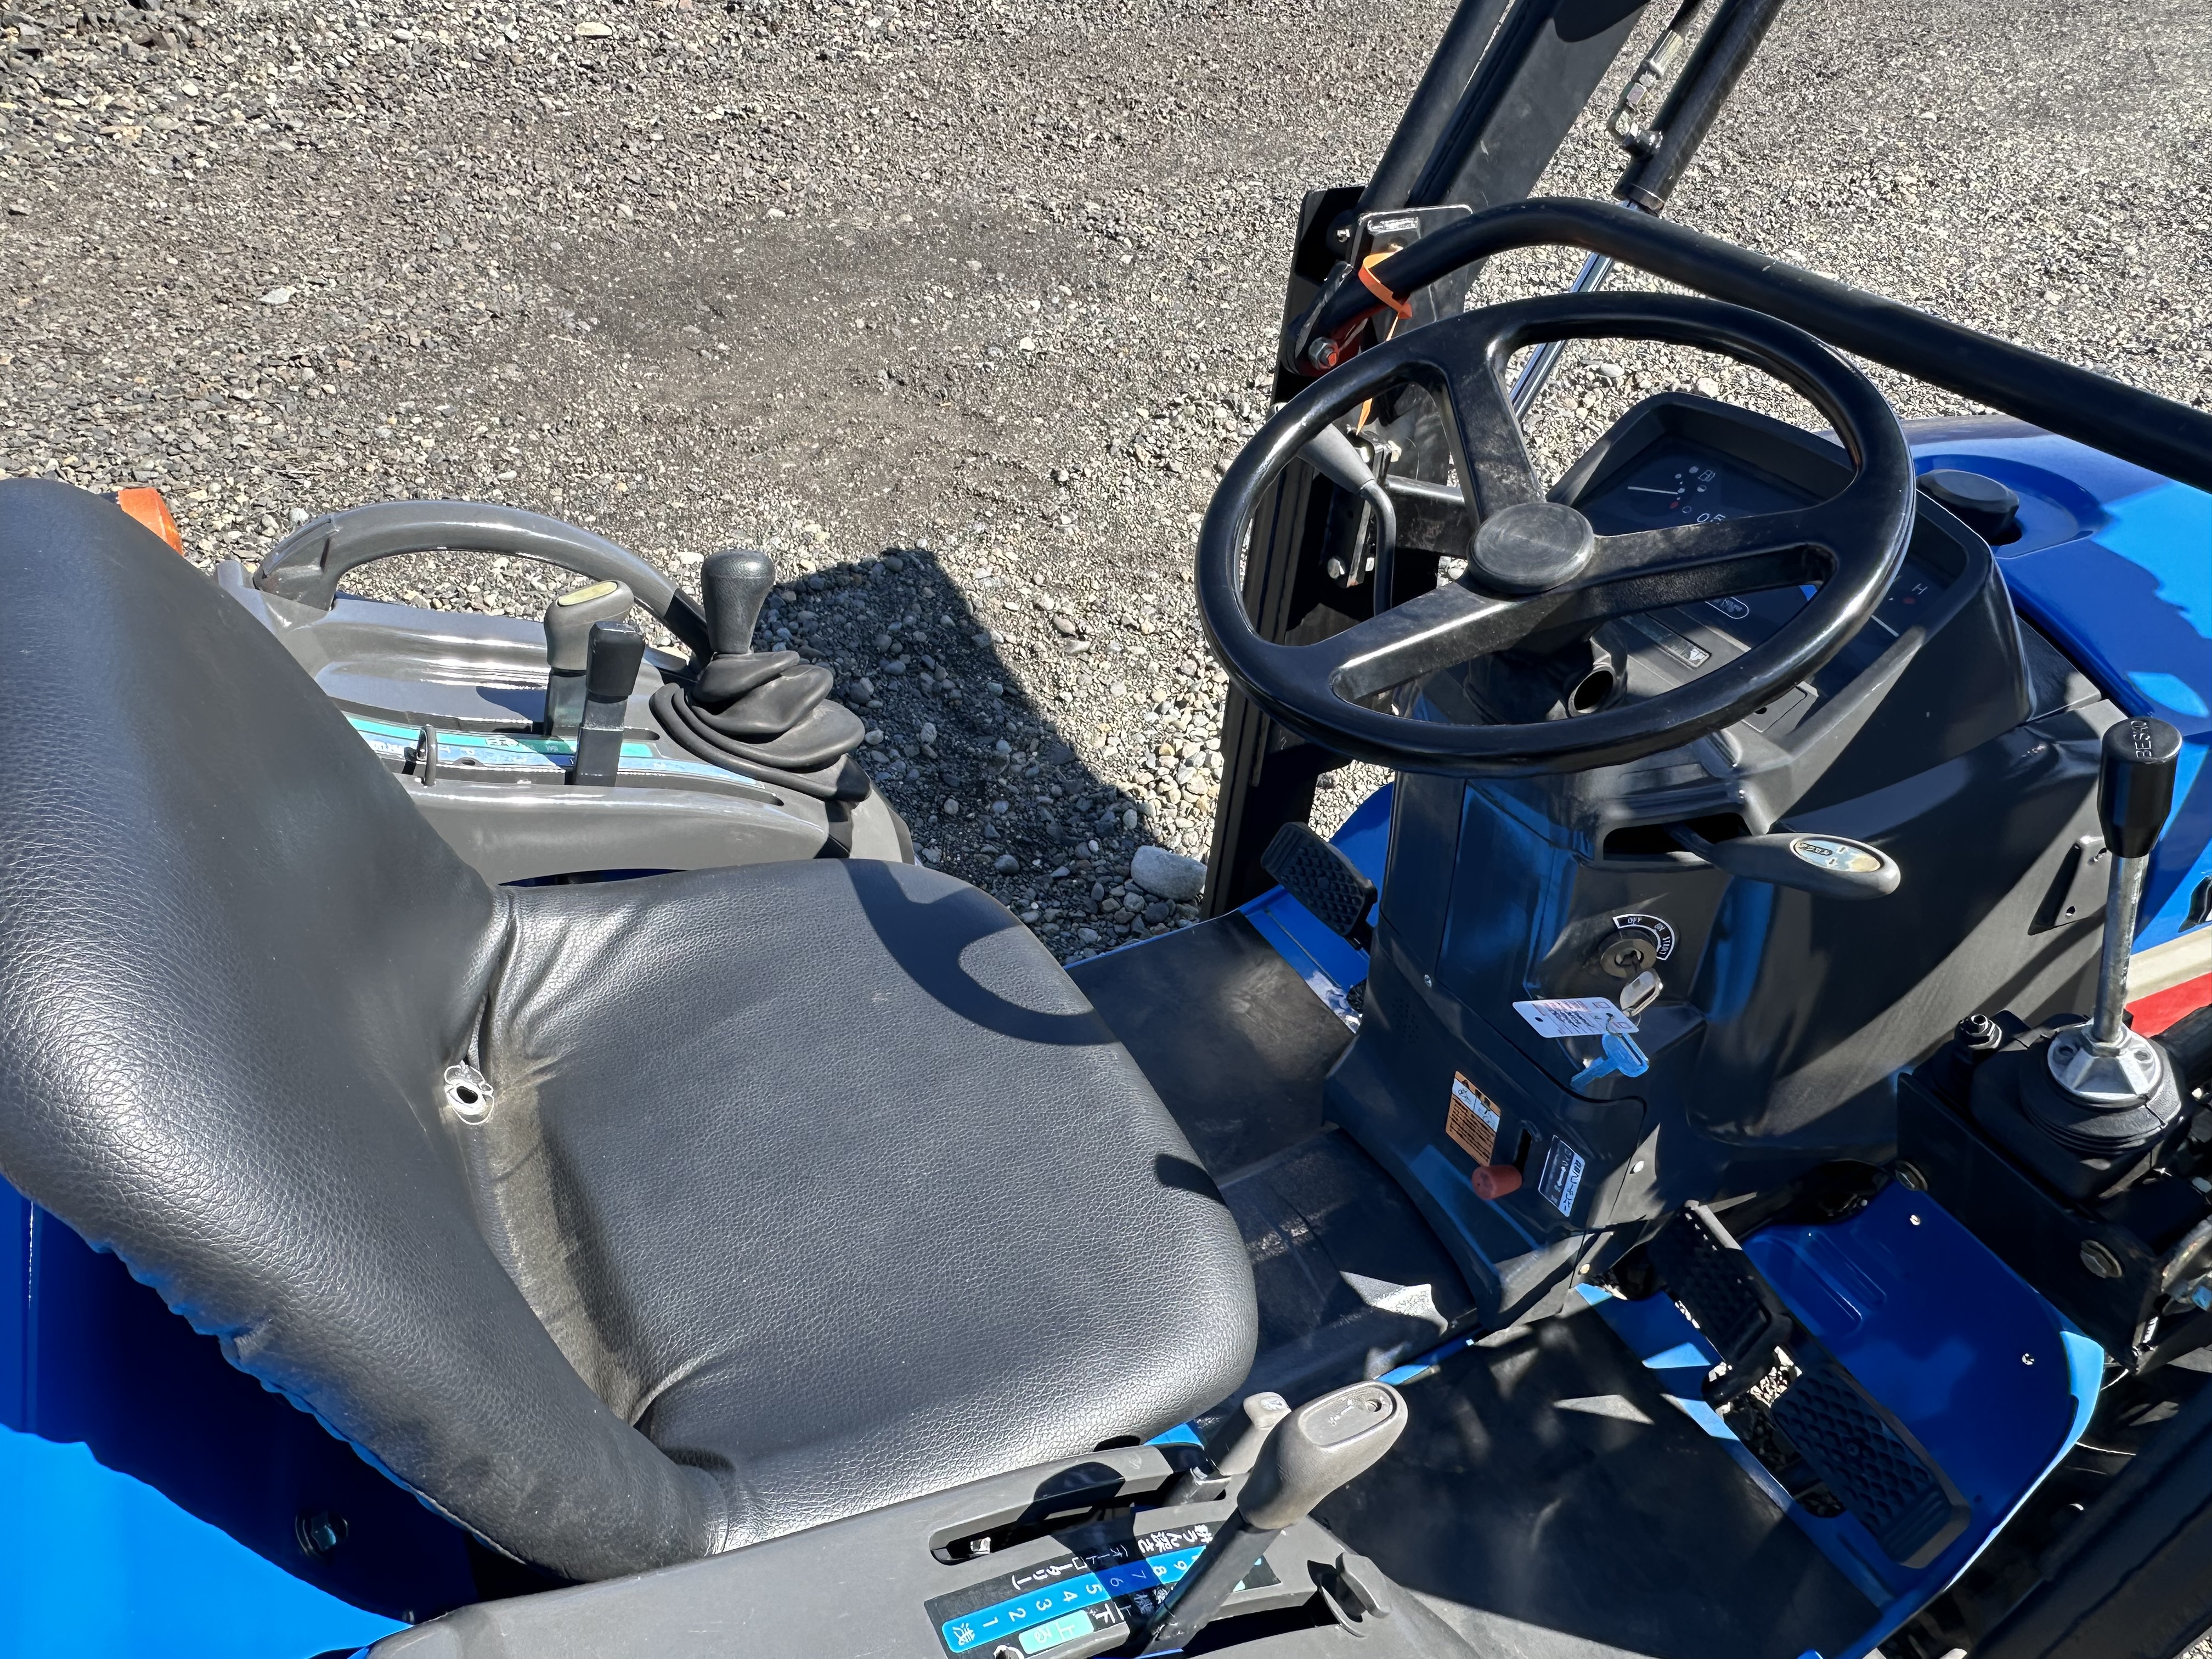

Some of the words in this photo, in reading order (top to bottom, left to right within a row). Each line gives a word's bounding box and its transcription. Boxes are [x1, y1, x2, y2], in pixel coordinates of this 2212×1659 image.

[1173, 1560, 1188, 1571] 9
[1131, 1570, 1147, 1579] 7
[1153, 1566, 1167, 1577] 8
[1110, 1577, 1124, 1587] 6
[1086, 1584, 1103, 1595] 5
[1063, 1590, 1078, 1602] 4
[1036, 1599, 1053, 1611] 3
[1008, 1607, 1027, 1622] 2
[982, 1616, 999, 1628] 1
[952, 1622, 975, 1646] 浅
